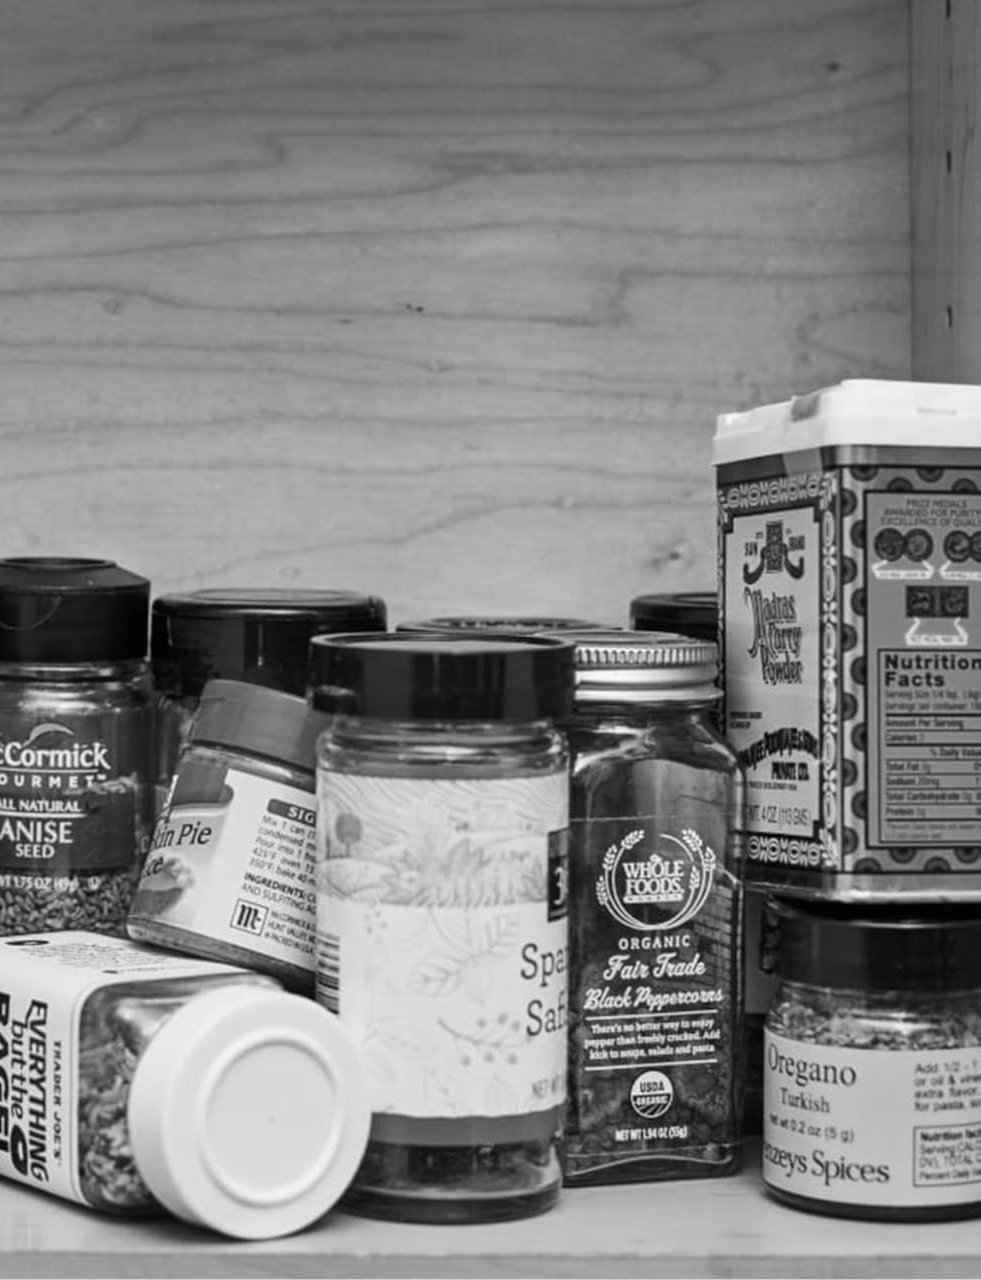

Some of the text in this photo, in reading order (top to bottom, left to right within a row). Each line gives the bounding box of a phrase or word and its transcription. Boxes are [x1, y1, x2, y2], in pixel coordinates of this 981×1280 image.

[885, 671, 945, 687] Facts
[18, 800, 83, 813] NATURAL
[176, 820, 213, 846] Pie
[15, 843, 56, 859] SEED
[622, 861, 684, 878] WHOLE
[626, 878, 684, 895] FOODS
[618, 936, 691, 950] ORGANIC
[603, 952, 707, 982] Fair Trade
[583, 986, 724, 1012] Black Peppercorns
[11, 1019, 29, 1120] but the
[52, 1040, 63, 1107] TRADER
[769, 1043, 858, 1087] Oregano
[25, 999, 49, 1183] EVERYTHING
[639, 1081, 665, 1093] USDA
[779, 1087, 830, 1114] Turkish
[811, 1148, 890, 1186] Spices
